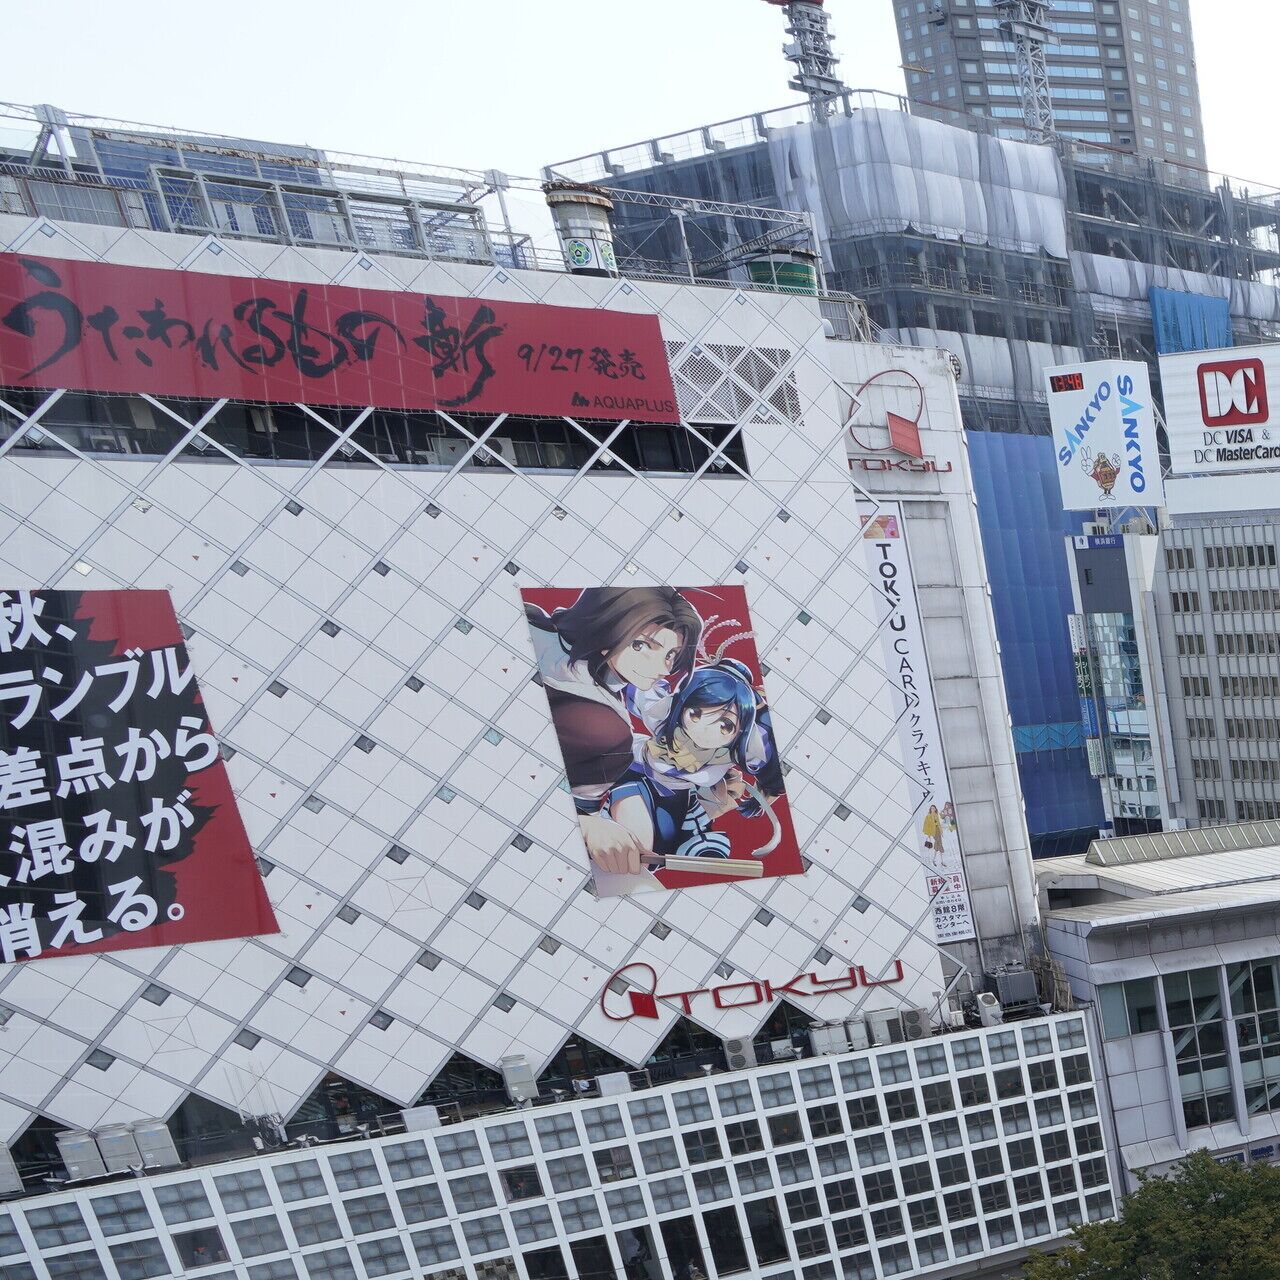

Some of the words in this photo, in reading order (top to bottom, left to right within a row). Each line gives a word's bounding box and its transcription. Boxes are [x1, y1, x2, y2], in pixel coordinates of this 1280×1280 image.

[594, 396, 675, 413] AQUAPLUS
[1203, 368, 1259, 418] DC
[1059, 381, 1110, 466] SANKYO
[1117, 375, 1146, 493] SANKYO
[1204, 431, 1224, 447] DC
[1225, 428, 1253, 444] VISA
[1262, 429, 1271, 440] &
[848, 458, 953, 473] TOKYU
[1194, 449, 1212, 464] DC
[0, 716, 219, 810] 差点から
[0, 790, 195, 887] 混みが
[935, 914, 968, 923] カスタマー
[936, 920, 970, 930] センターへ
[656, 960, 904, 1015] TOKYU
